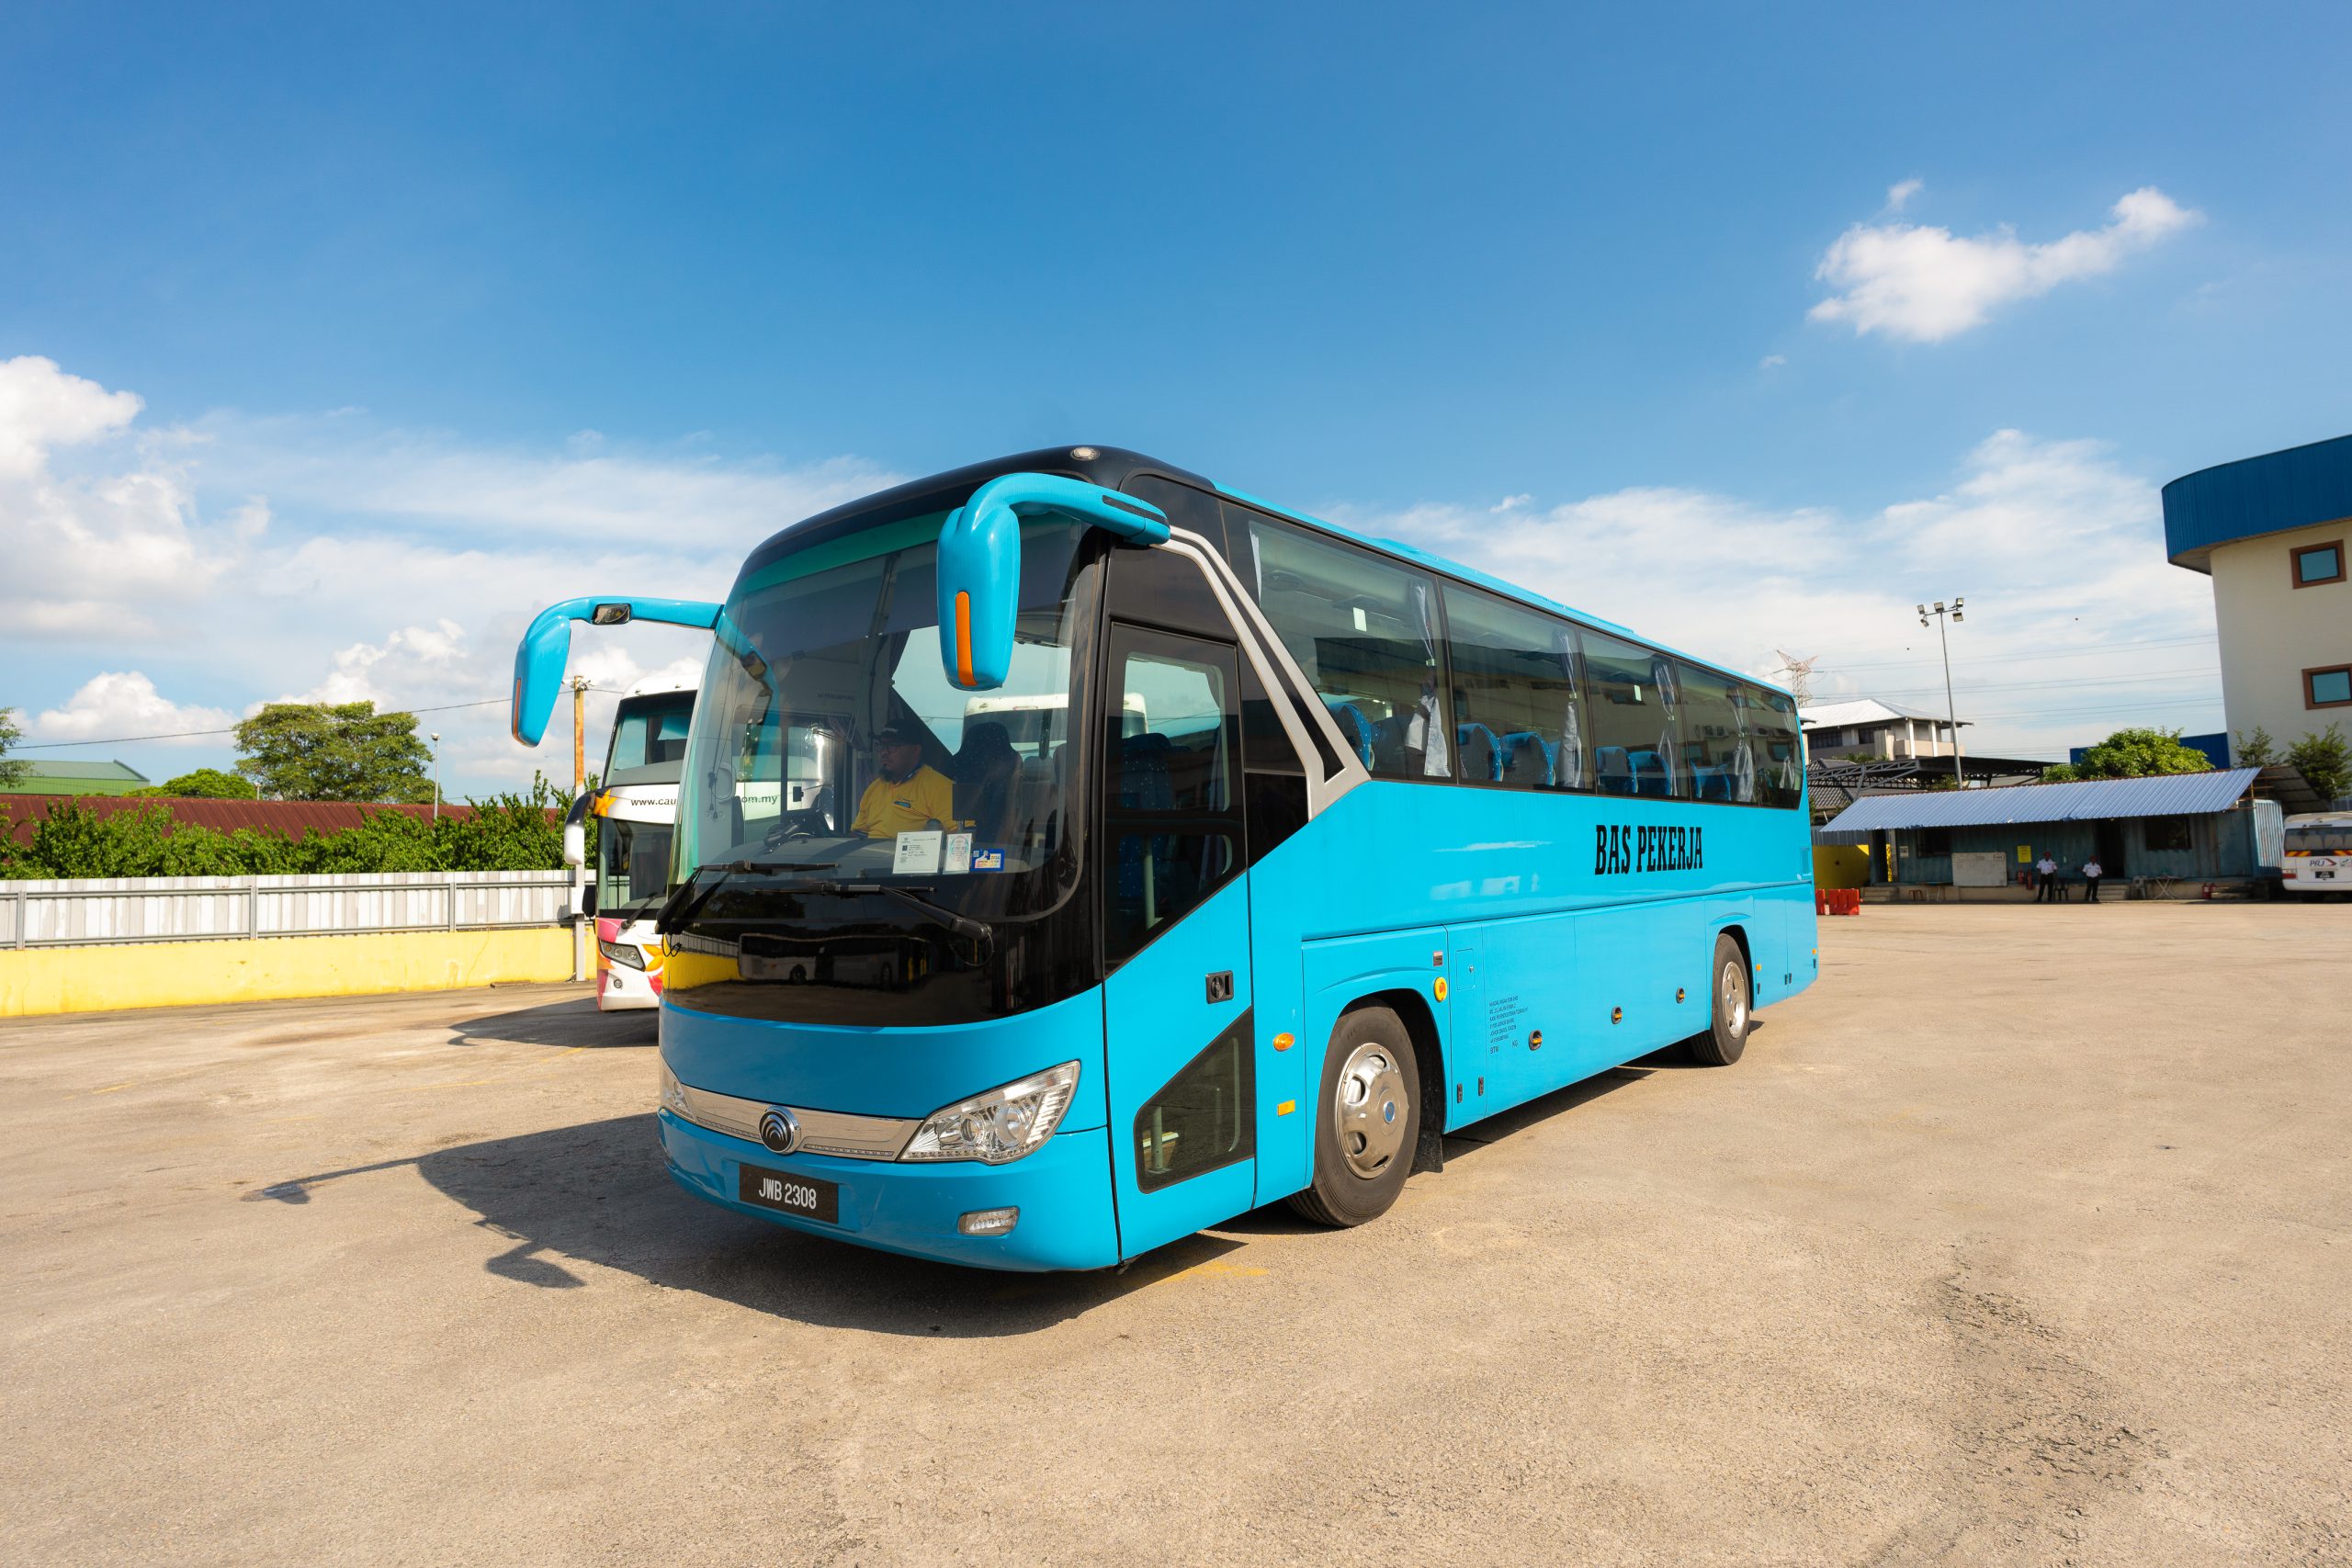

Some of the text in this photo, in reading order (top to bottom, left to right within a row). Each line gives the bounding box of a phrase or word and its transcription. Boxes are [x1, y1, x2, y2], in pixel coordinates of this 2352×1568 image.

[630, 795, 778, 807] www.cau om.my
[1594, 824, 1702, 875] BAS PEKERJA
[759, 1178, 817, 1210] JWB 2308
